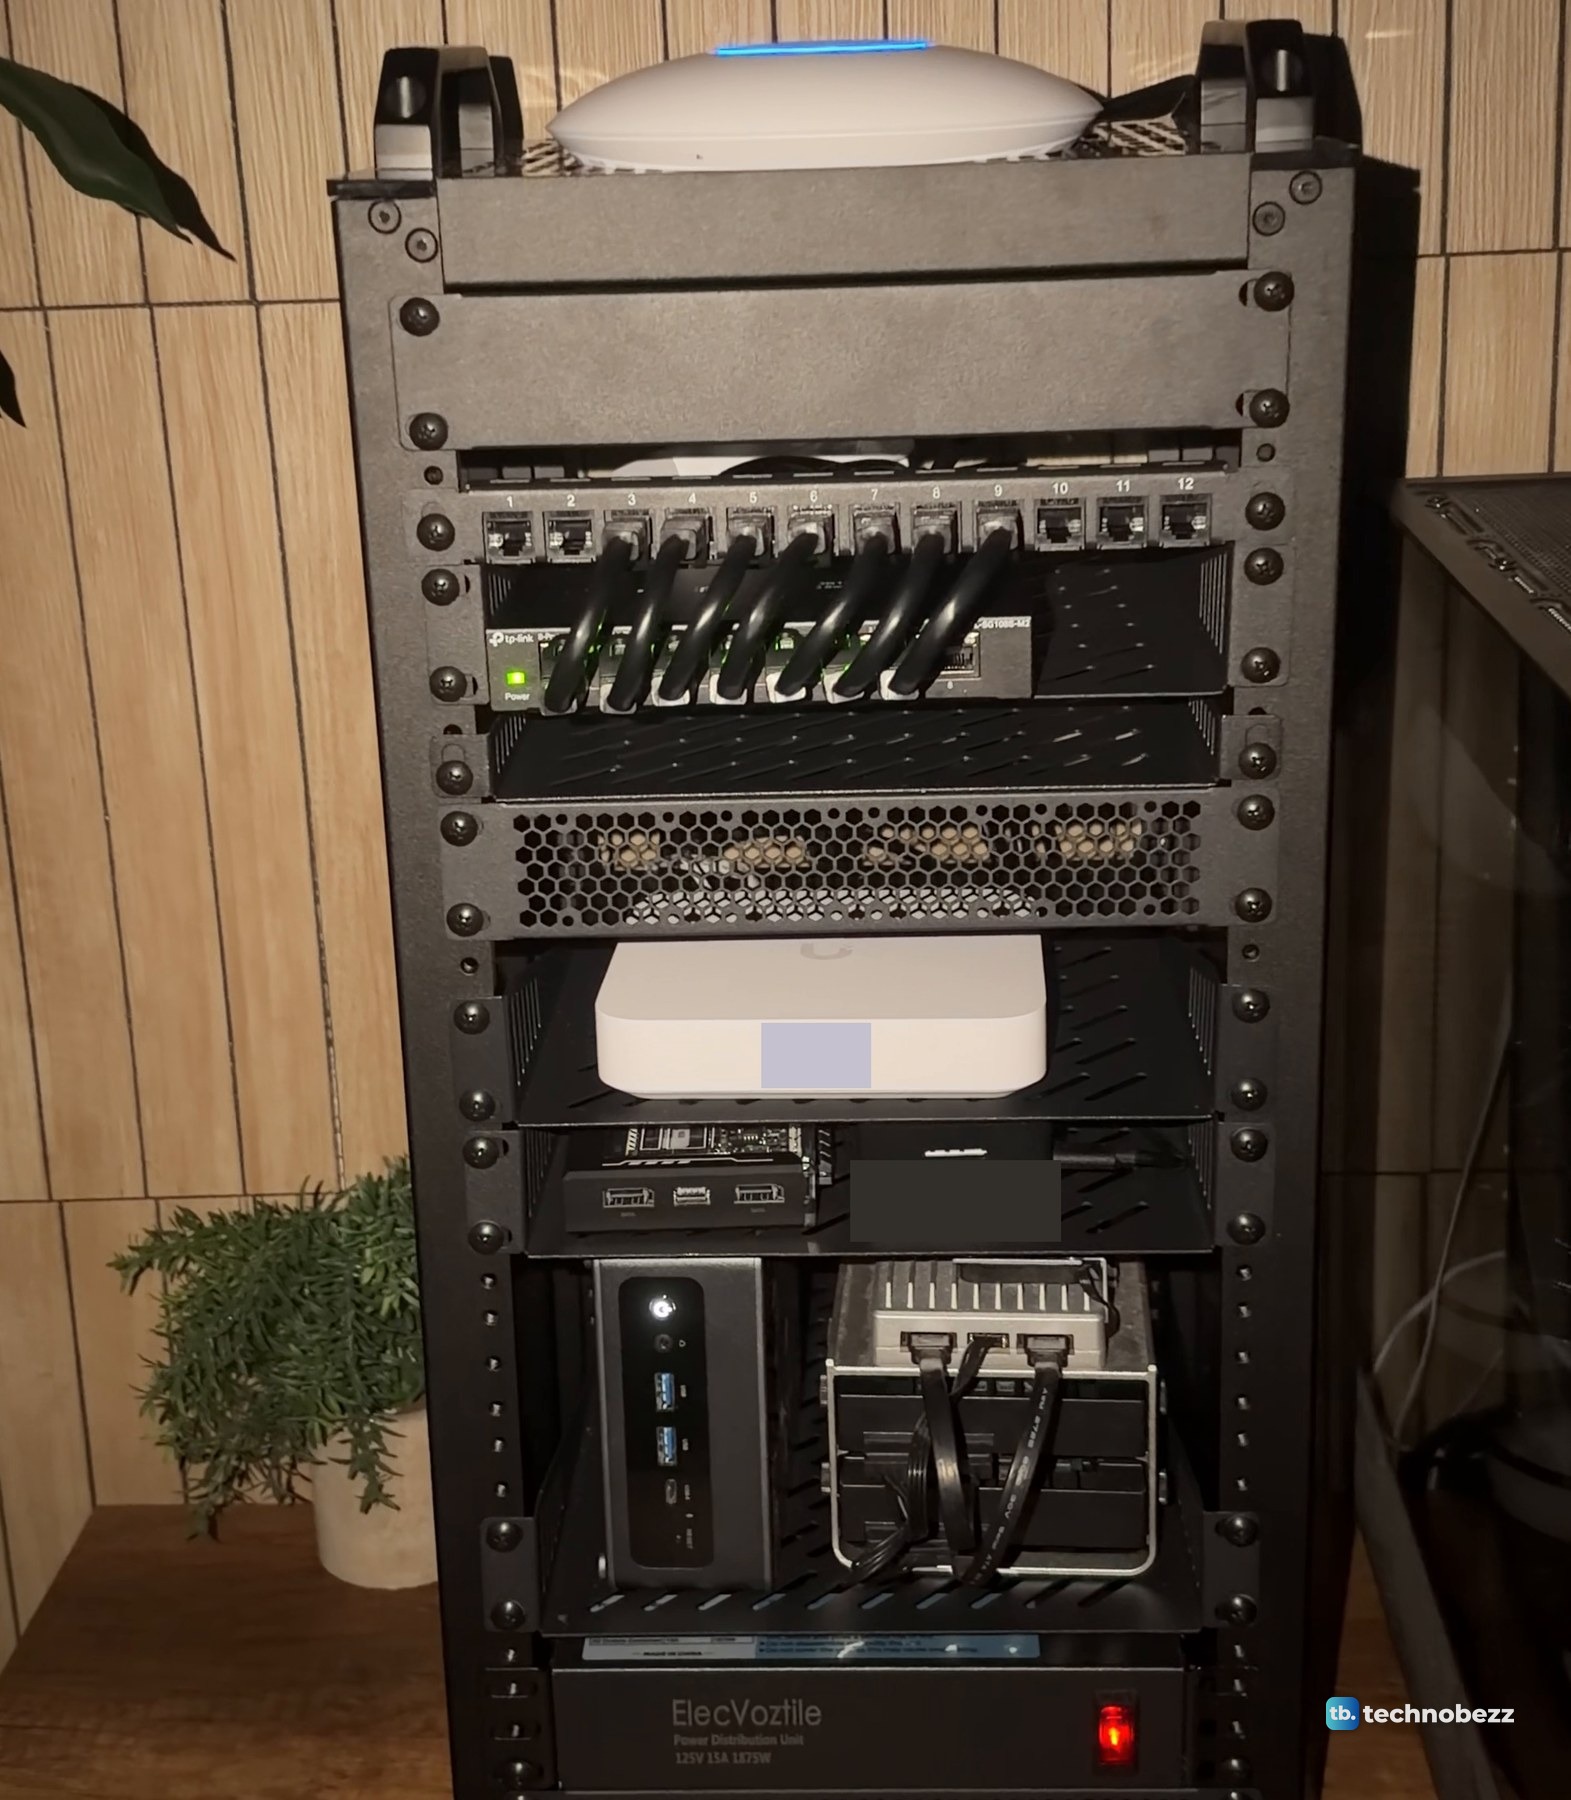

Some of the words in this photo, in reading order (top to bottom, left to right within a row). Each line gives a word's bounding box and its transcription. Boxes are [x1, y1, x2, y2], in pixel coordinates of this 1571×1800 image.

[506, 496, 514, 507] 1
[566, 494, 577, 507] 2
[627, 493, 637, 506] 3
[687, 492, 697, 505] 4
[749, 491, 758, 504] 5
[809, 490, 818, 503] 6
[871, 488, 879, 501] 7
[932, 487, 941, 499] 8
[993, 485, 1003, 497] 9
[1053, 482, 1069, 495] 10
[1116, 480, 1131, 492] 11
[1178, 477, 1194, 490] 12
[505, 633, 534, 645] tp-link
[505, 692, 531, 701] Power
[672, 1698, 822, 1727] ElecVoztile
[673, 1734, 709, 1746] Power
[711, 1733, 778, 1746] Distribution
[780, 1733, 804, 1746] Unit
[676, 1752, 705, 1765] 125V
[707, 1752, 730, 1765] 15A
[733, 1752, 772, 1765] 1875W
